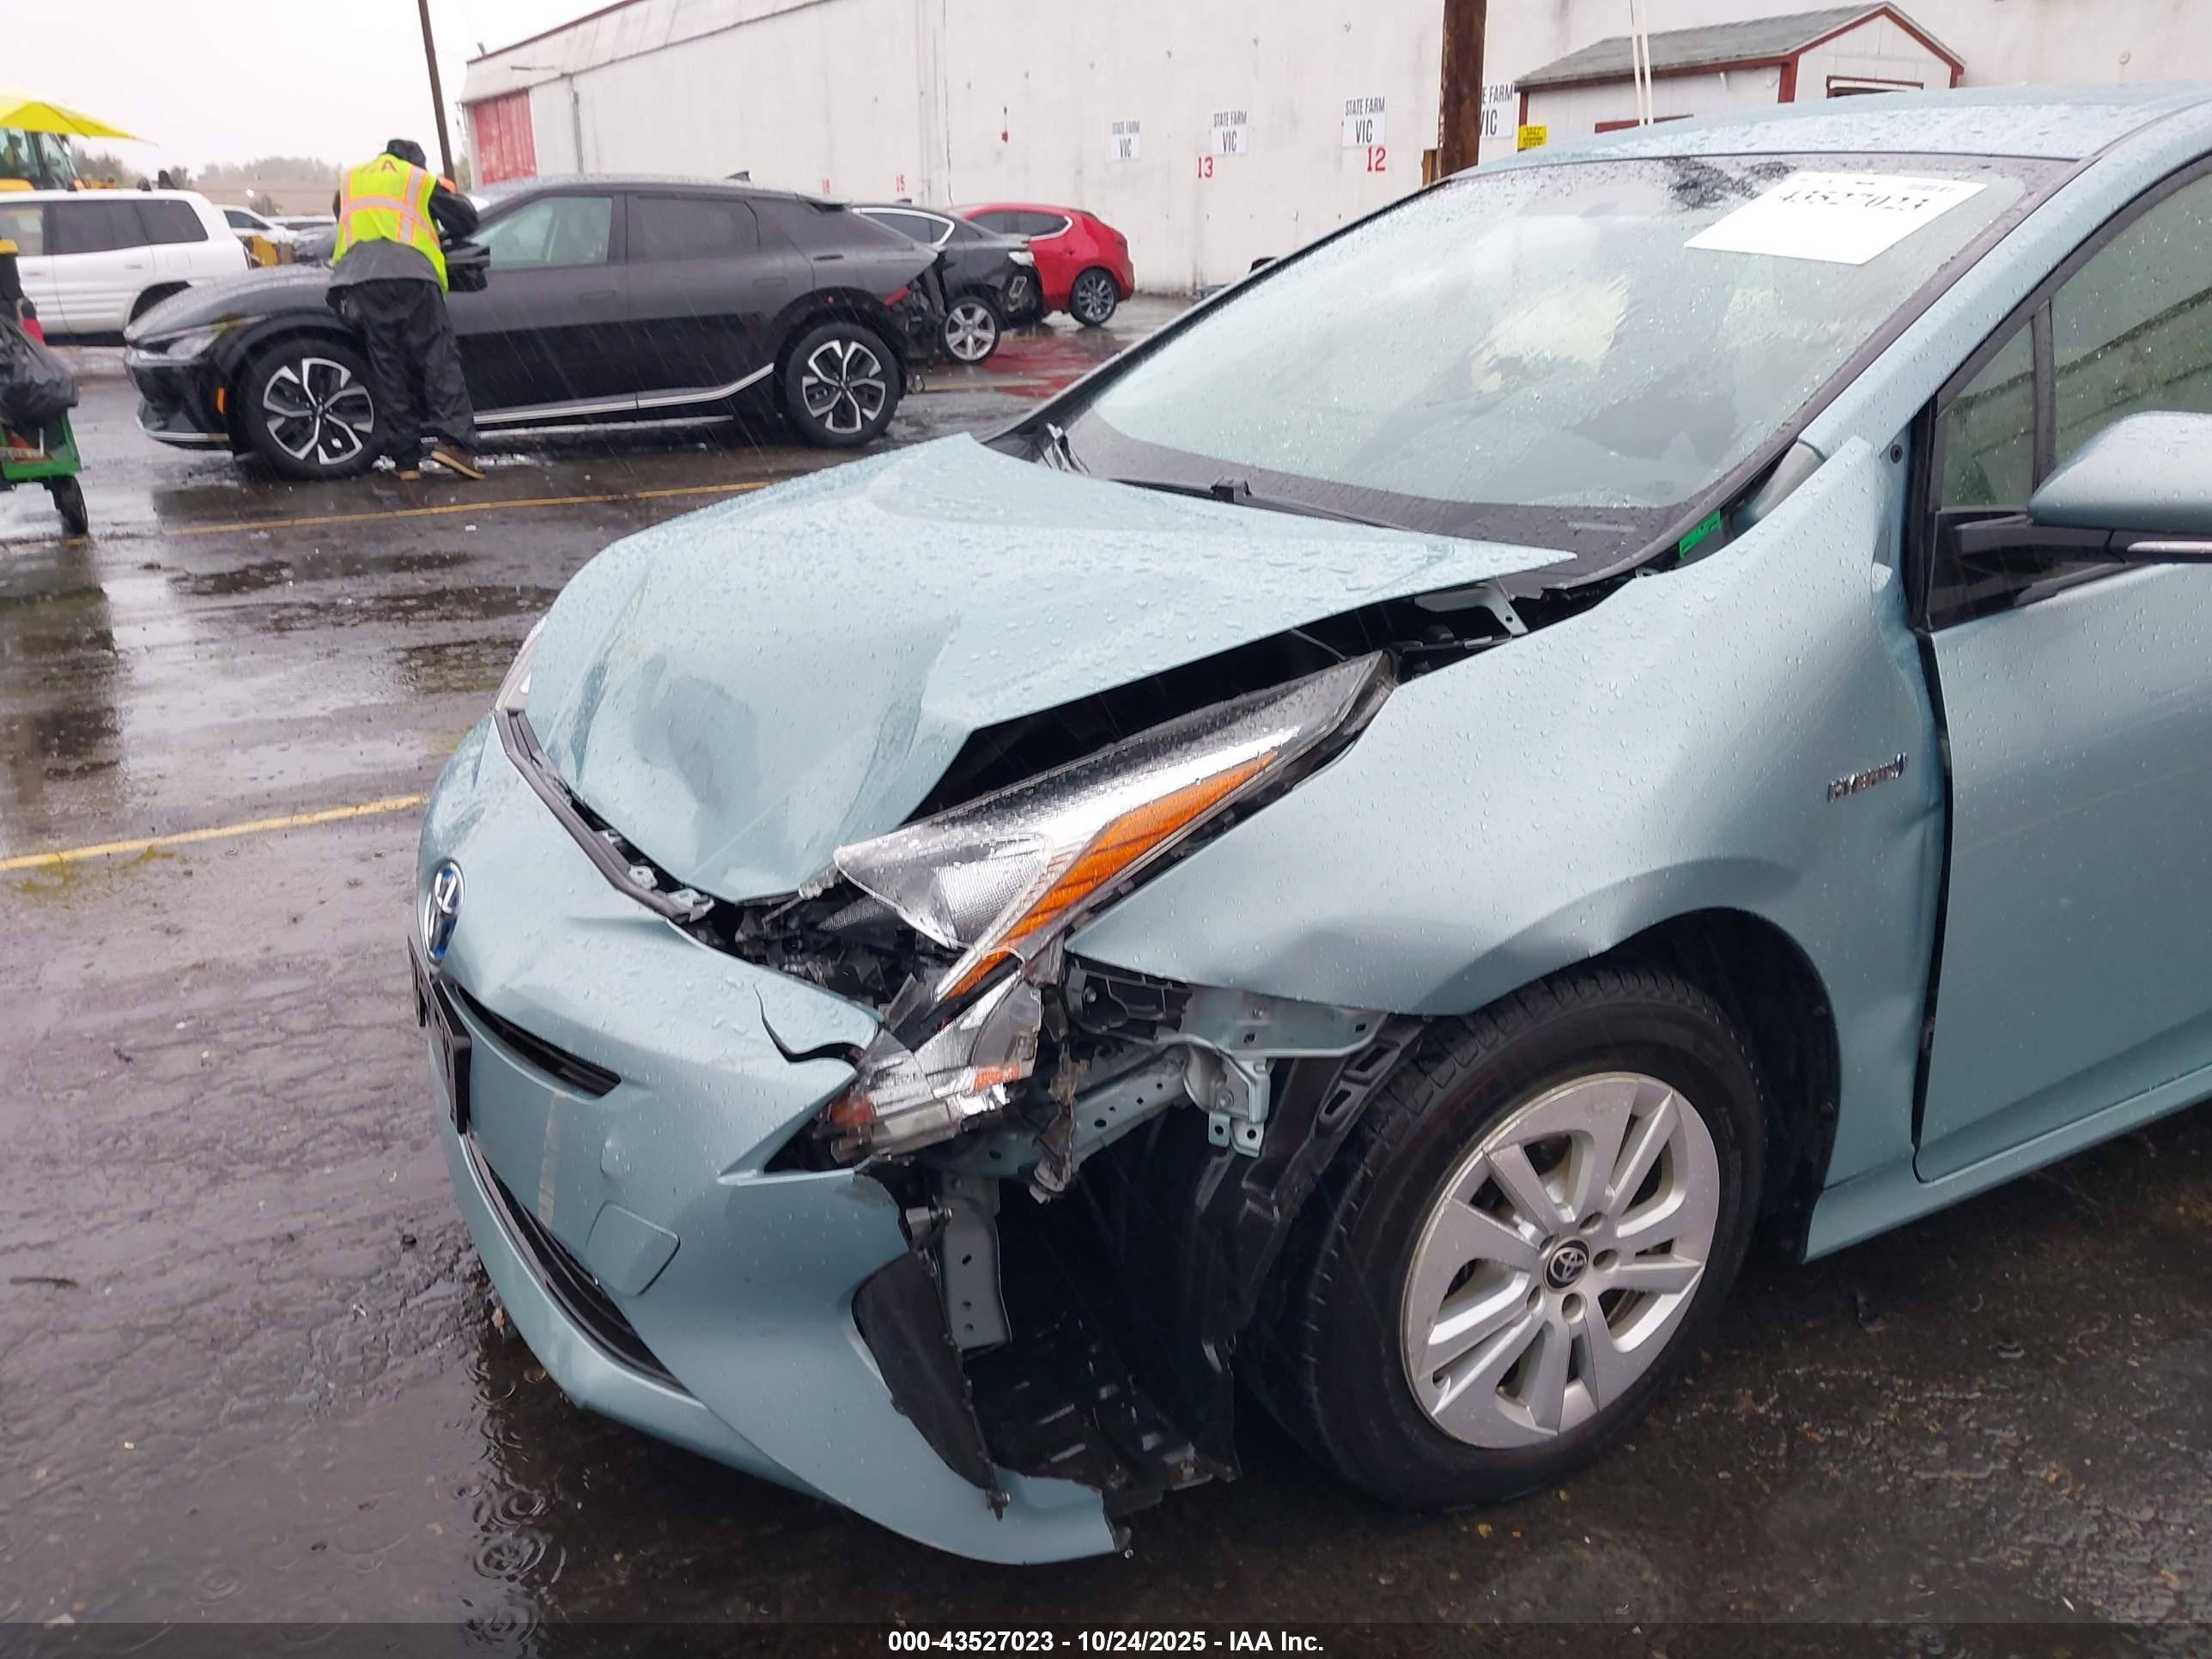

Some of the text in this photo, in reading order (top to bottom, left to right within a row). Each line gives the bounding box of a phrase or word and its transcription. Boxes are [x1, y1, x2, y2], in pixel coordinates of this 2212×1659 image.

[1489, 83, 1513, 104] FARM
[1345, 95, 1385, 117] STATE FARM
[1213, 109, 1247, 128] STATE FARM
[1222, 130, 1237, 153] VIC
[1355, 118, 1373, 144] VIC
[1119, 137, 1132, 159] VIC
[1366, 146, 1386, 172] 12
[1197, 155, 1213, 179] 13
